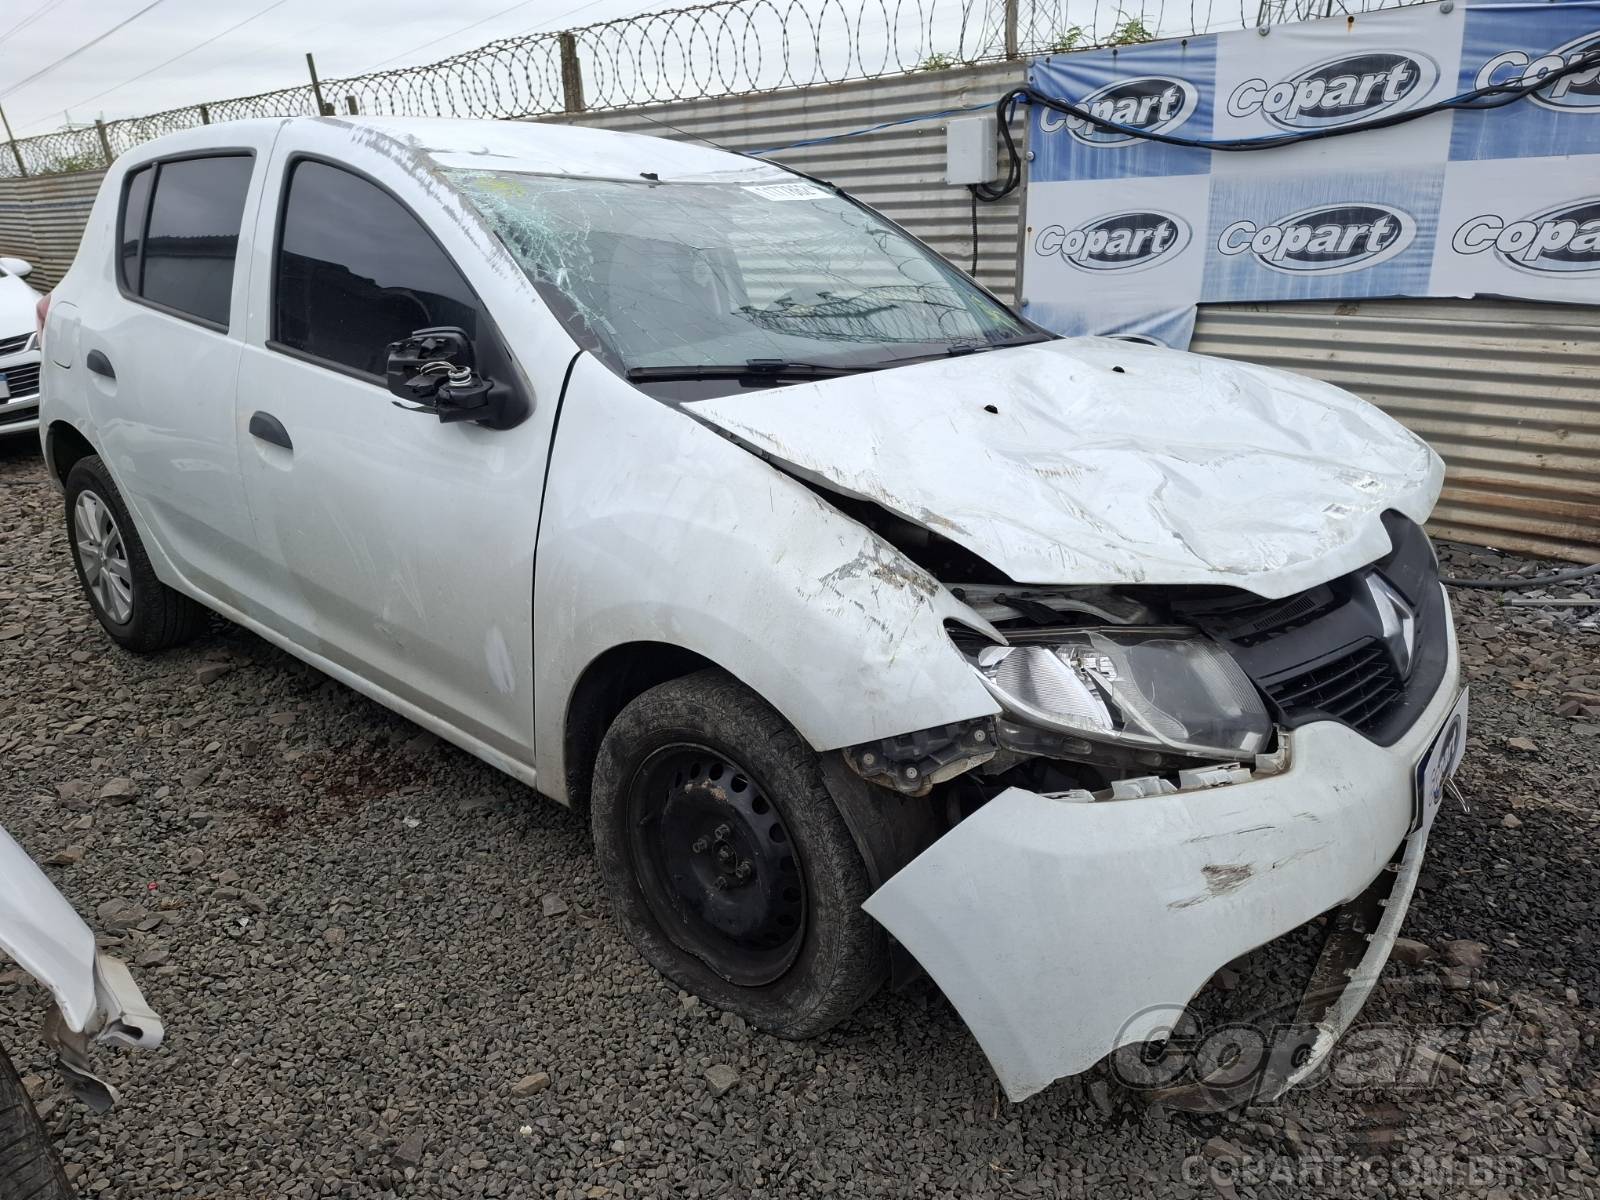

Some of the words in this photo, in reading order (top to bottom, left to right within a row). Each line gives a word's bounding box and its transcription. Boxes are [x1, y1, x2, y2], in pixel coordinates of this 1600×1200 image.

[1039, 84, 1181, 136] Copart
[1226, 58, 1413, 120] Copart
[1034, 216, 1174, 261] Copart
[1217, 214, 1393, 261] Copart
